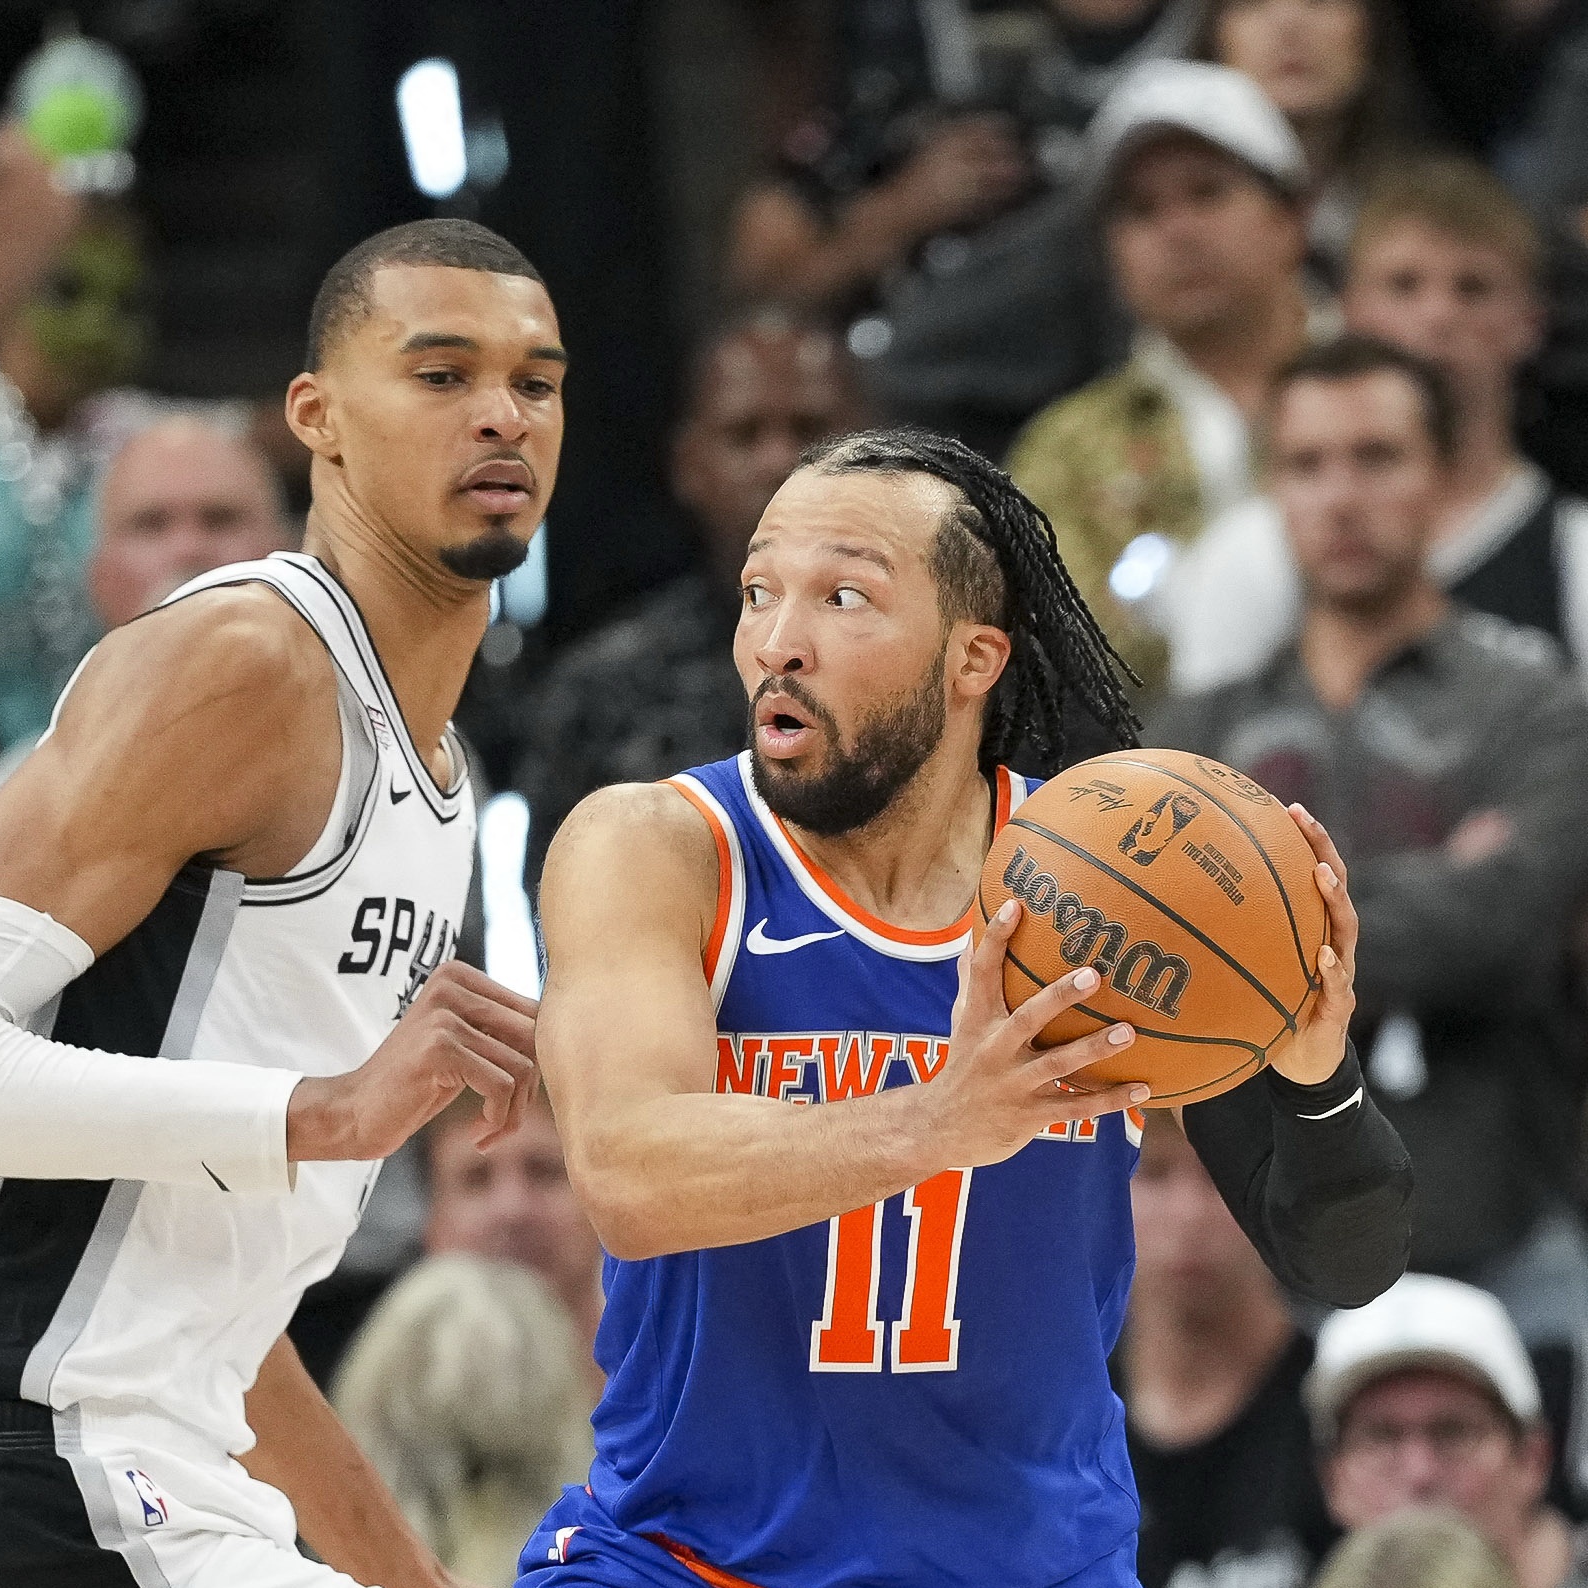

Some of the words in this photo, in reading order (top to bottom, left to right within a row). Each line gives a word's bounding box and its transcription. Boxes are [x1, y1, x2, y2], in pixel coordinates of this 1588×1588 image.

[1181, 840, 1201, 861] BALL
[1197, 856, 1219, 877] GAME
[1215, 874, 1245, 905] OFFICIAL
[1003, 844, 1191, 1019] Wilson
[809, 1167, 961, 1374] 11
